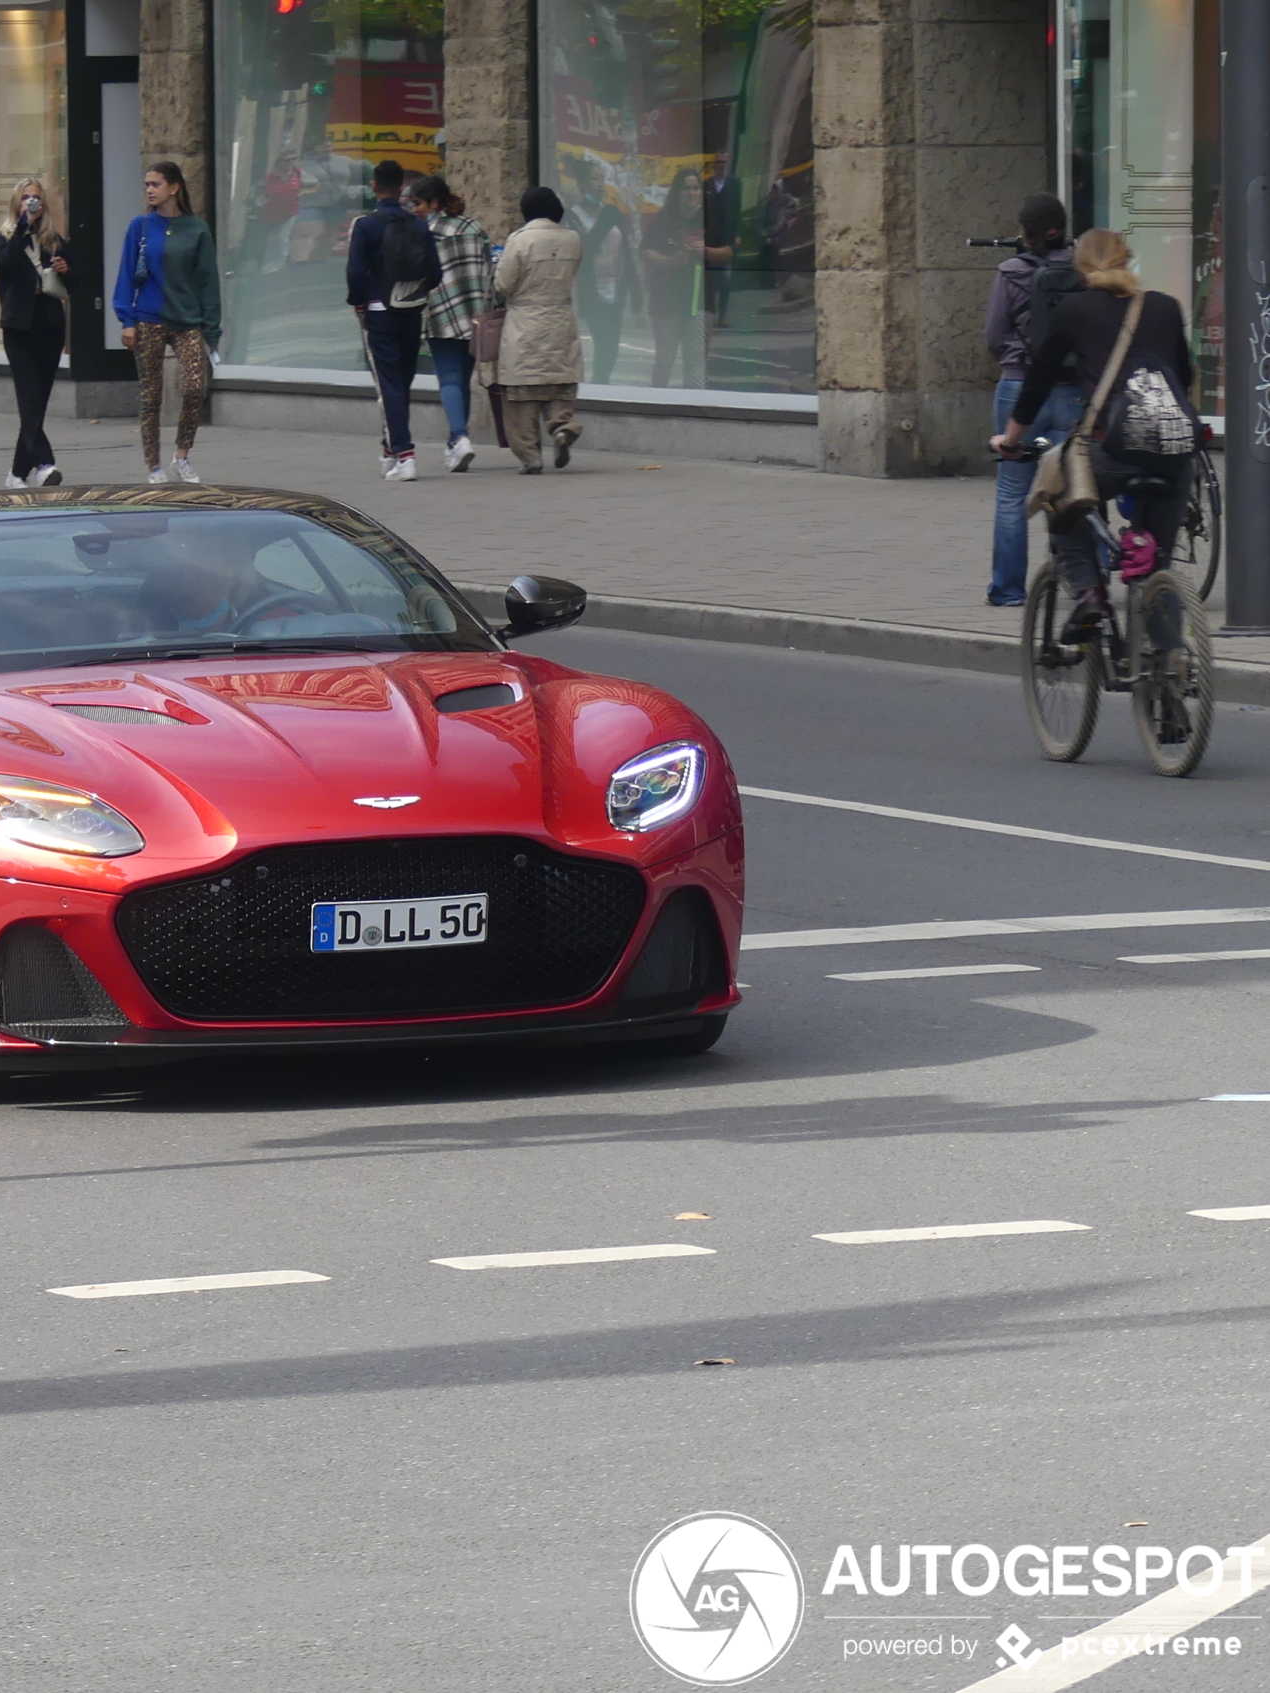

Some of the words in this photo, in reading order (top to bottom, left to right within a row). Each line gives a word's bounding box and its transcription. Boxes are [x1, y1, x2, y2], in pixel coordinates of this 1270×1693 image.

[338, 910, 361, 945] D
[384, 907, 431, 943] LL
[440, 902, 484, 939] 50
[320, 932, 328, 943] D
